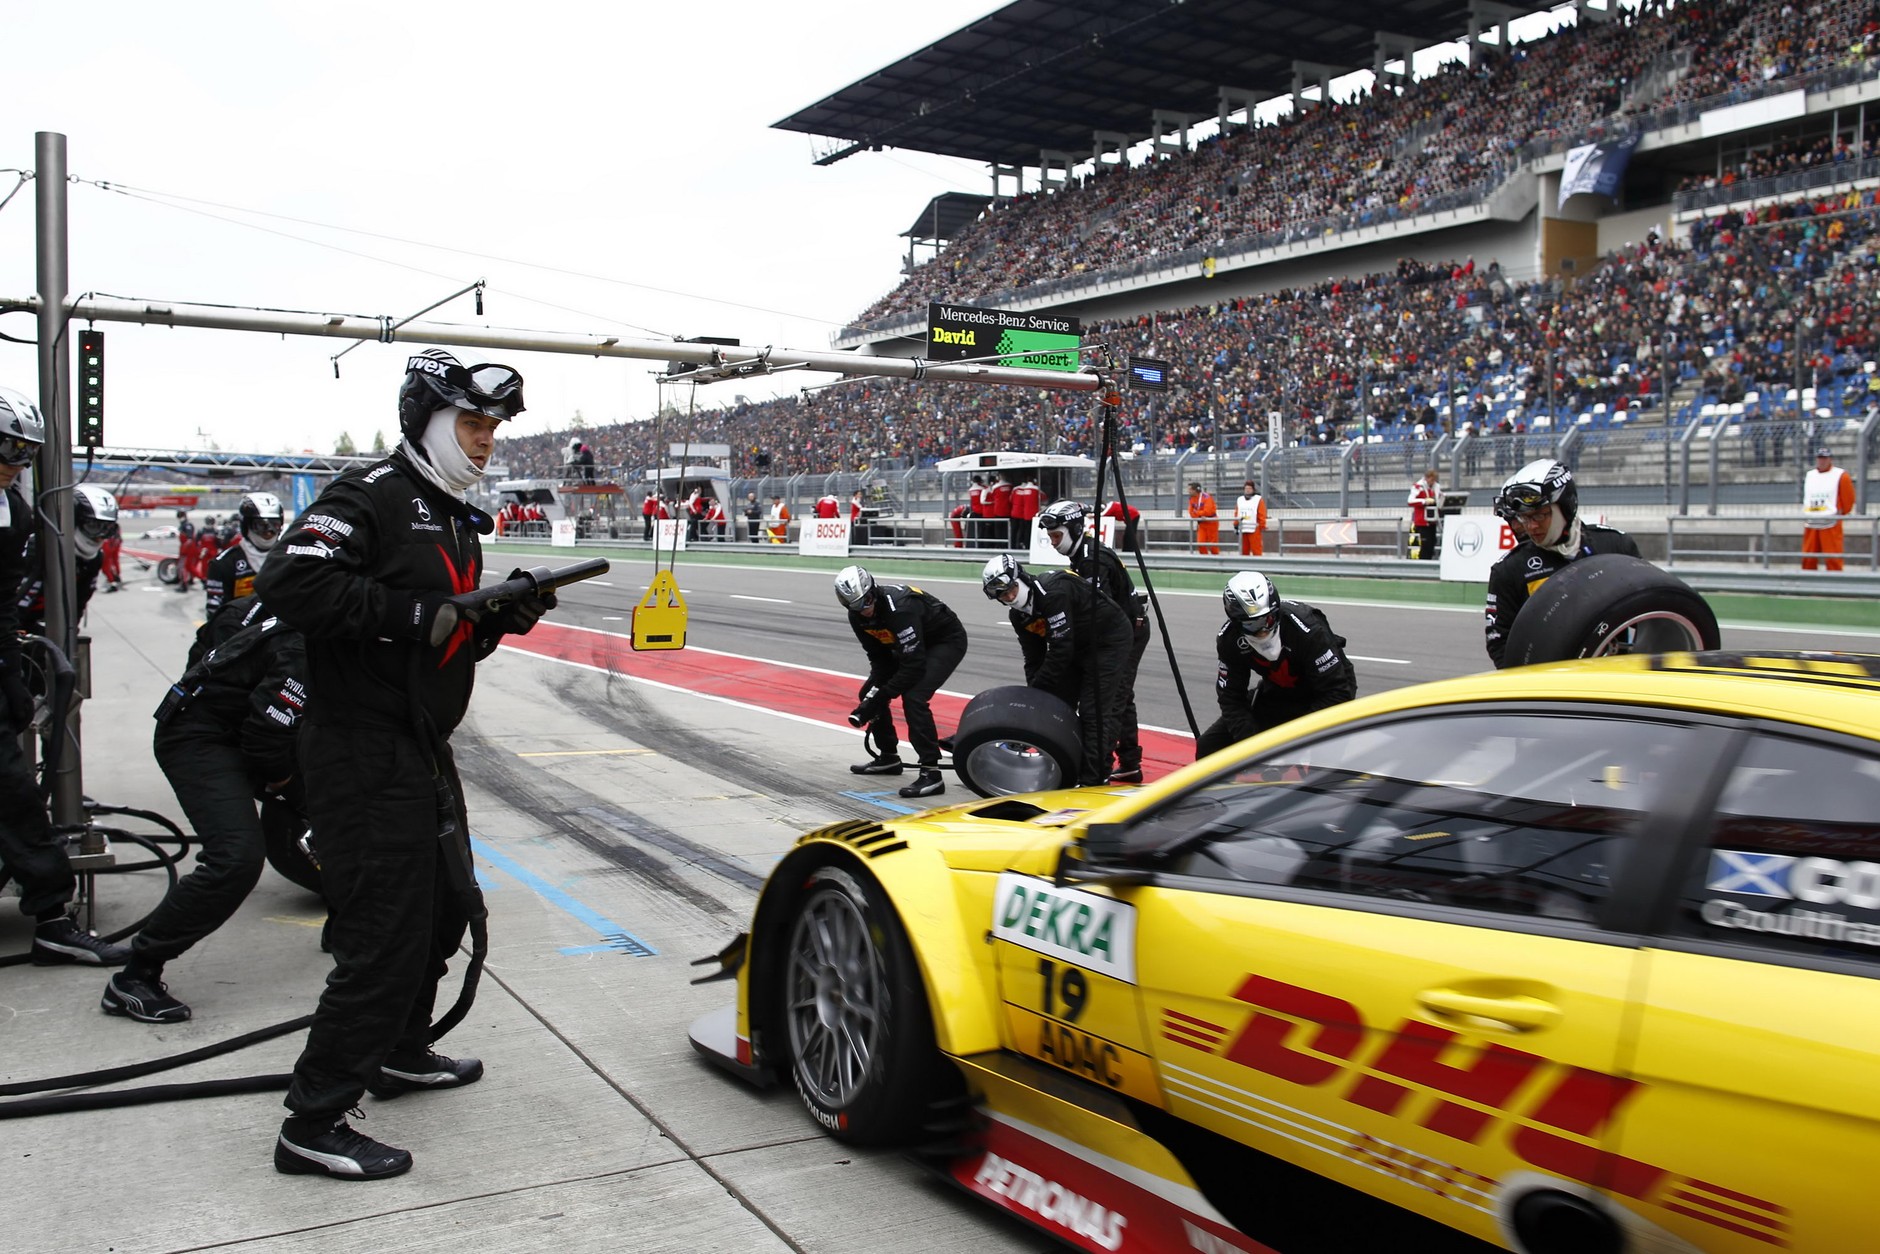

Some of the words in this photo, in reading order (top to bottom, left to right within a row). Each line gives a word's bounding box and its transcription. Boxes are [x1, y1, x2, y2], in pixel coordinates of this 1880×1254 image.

[940, 307, 1027, 328] Mercedes-Benz
[1028, 316, 1070, 332] Service
[932, 327, 976, 346] David
[408, 357, 450, 379] uvex
[1022, 349, 1069, 367] Robert
[307, 514, 353, 537] SYNTIUM
[1064, 511, 1083, 521] uvex
[816, 524, 847, 538] BOSCH
[1003, 885, 1115, 963] DEKRA
[1038, 956, 1088, 1024] 19
[1040, 1018, 1122, 1088] ADAC
[1229, 972, 1672, 1200] DHL
[974, 1150, 1128, 1252] PETRONAS
